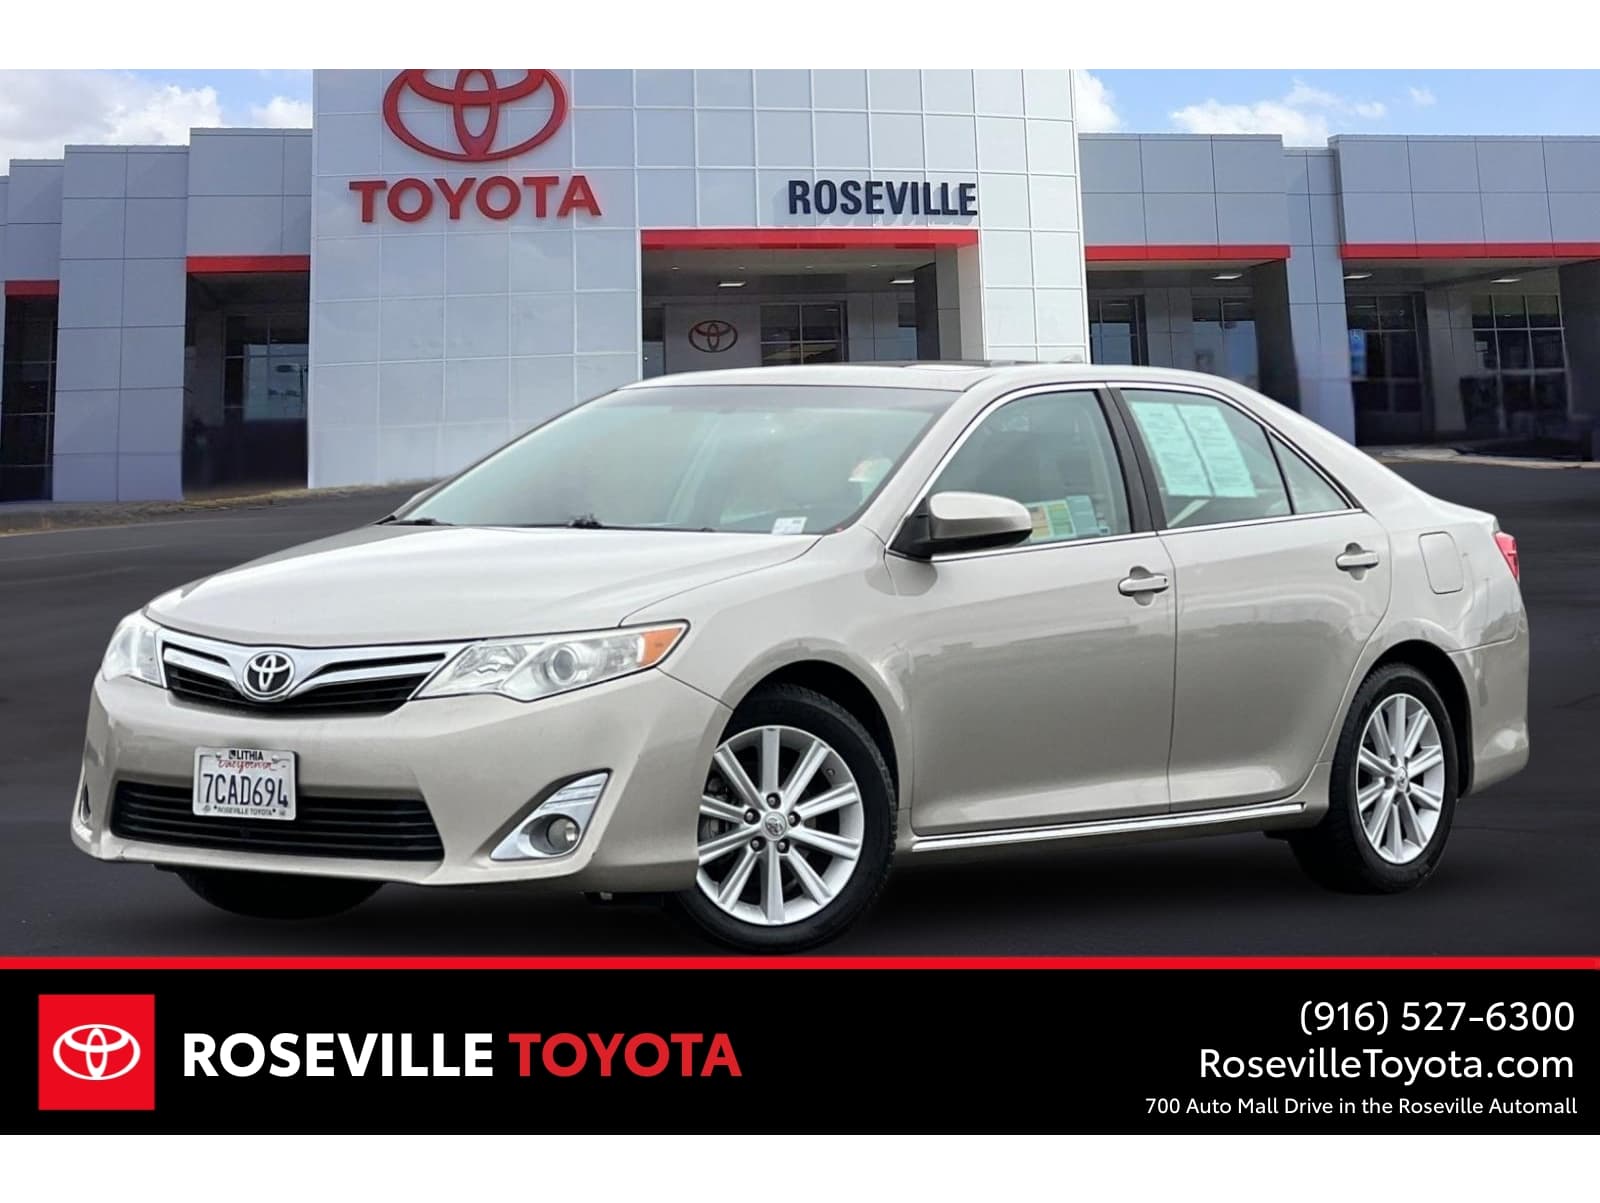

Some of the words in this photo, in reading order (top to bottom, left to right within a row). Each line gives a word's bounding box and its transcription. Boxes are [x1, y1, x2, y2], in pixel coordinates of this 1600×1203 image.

[349, 174, 602, 223] TOYOTA
[788, 180, 978, 217] ROSEVILLE
[236, 749, 264, 761] LITHIA
[202, 773, 289, 808] 7CAD694
[250, 807, 273, 816] TOYOTA
